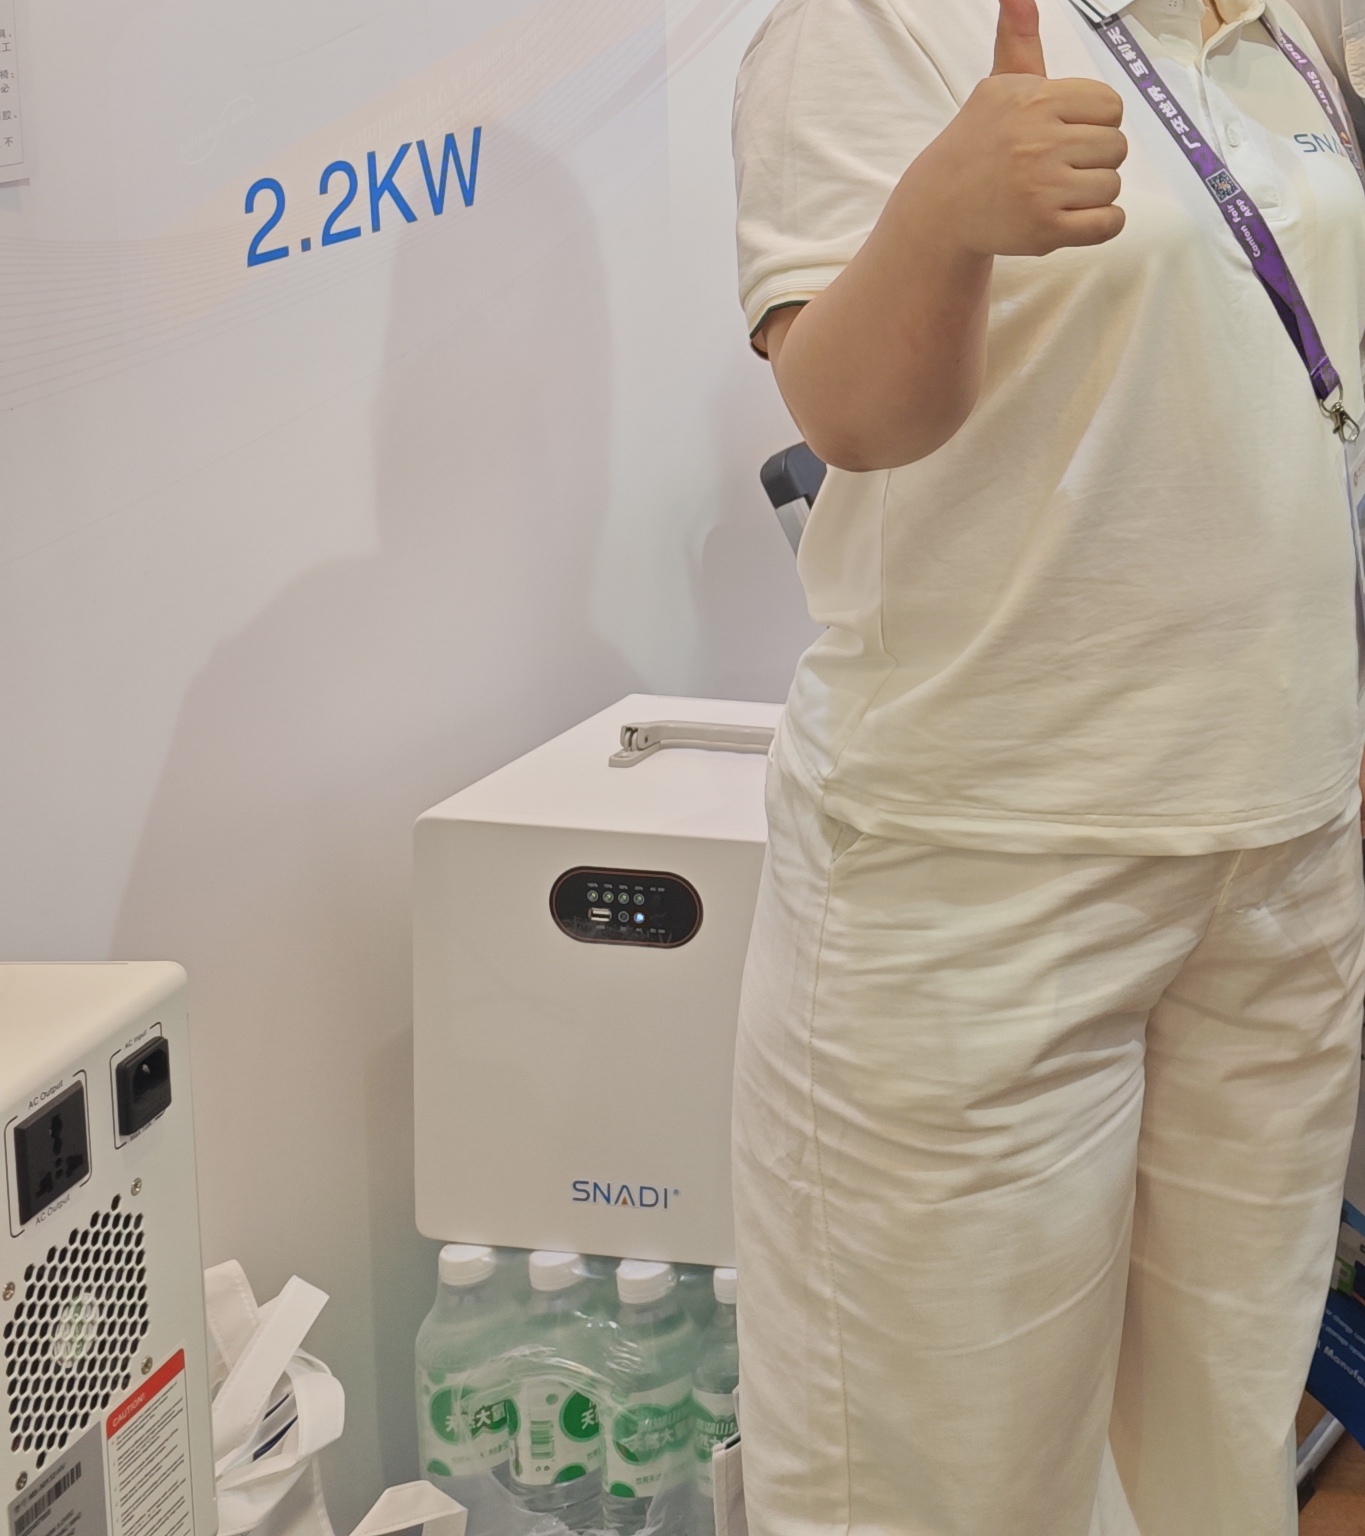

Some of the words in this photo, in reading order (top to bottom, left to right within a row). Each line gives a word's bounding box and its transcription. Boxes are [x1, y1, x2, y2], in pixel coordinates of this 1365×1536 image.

[244, 125, 482, 268] 2.2KW
[28, 1095, 39, 1109] AC
[41, 1079, 64, 1101] Output
[35, 1212, 46, 1226] AC
[47, 1194, 71, 1216] Output
